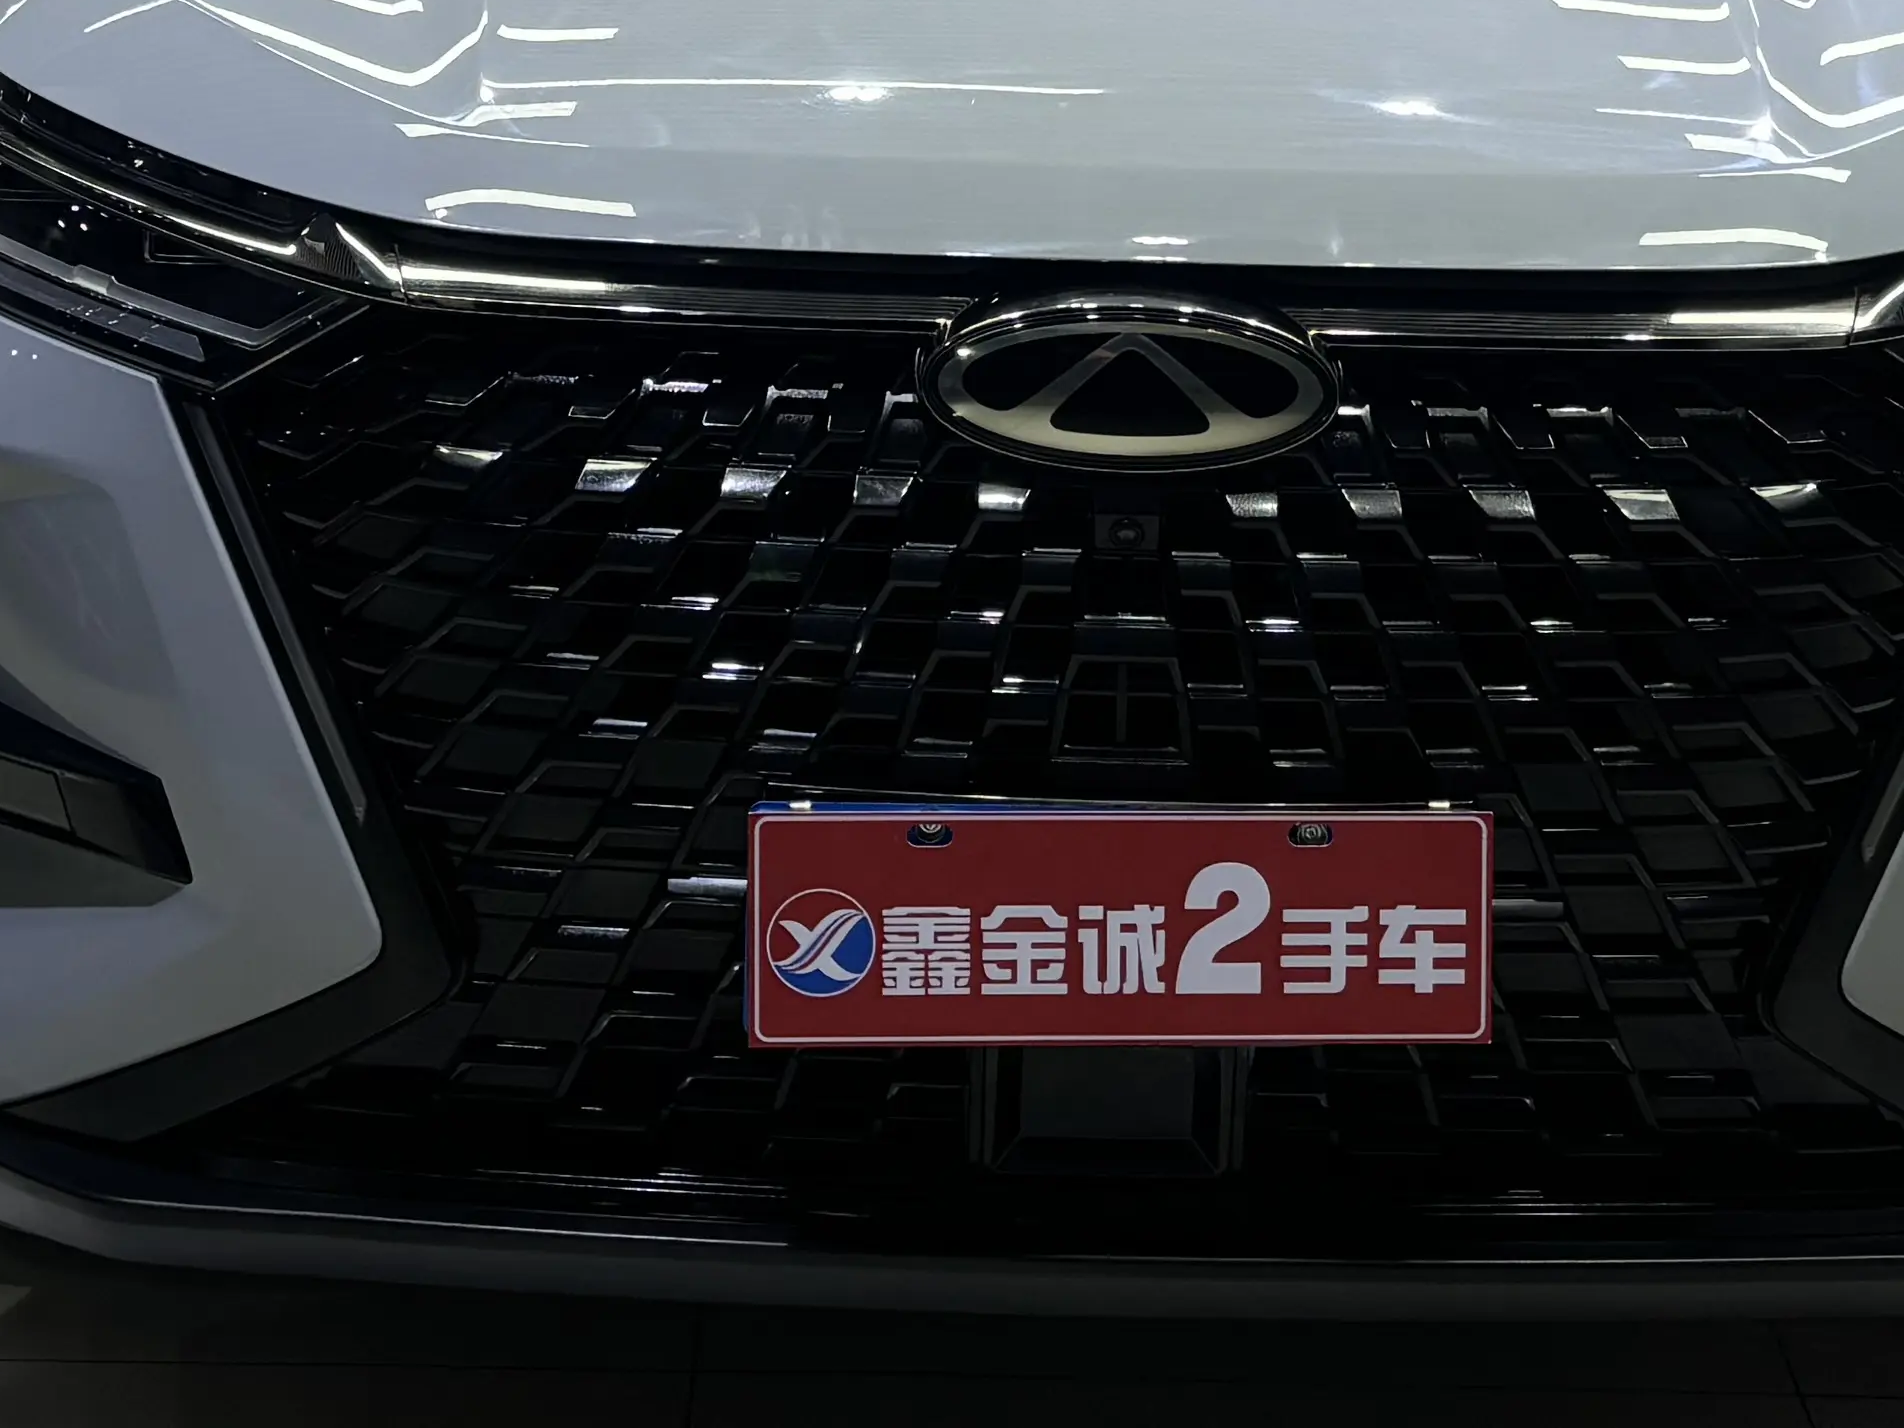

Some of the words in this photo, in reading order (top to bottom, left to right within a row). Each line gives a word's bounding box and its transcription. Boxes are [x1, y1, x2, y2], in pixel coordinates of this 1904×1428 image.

[882, 862, 1466, 997] 鑫金诚2手车
